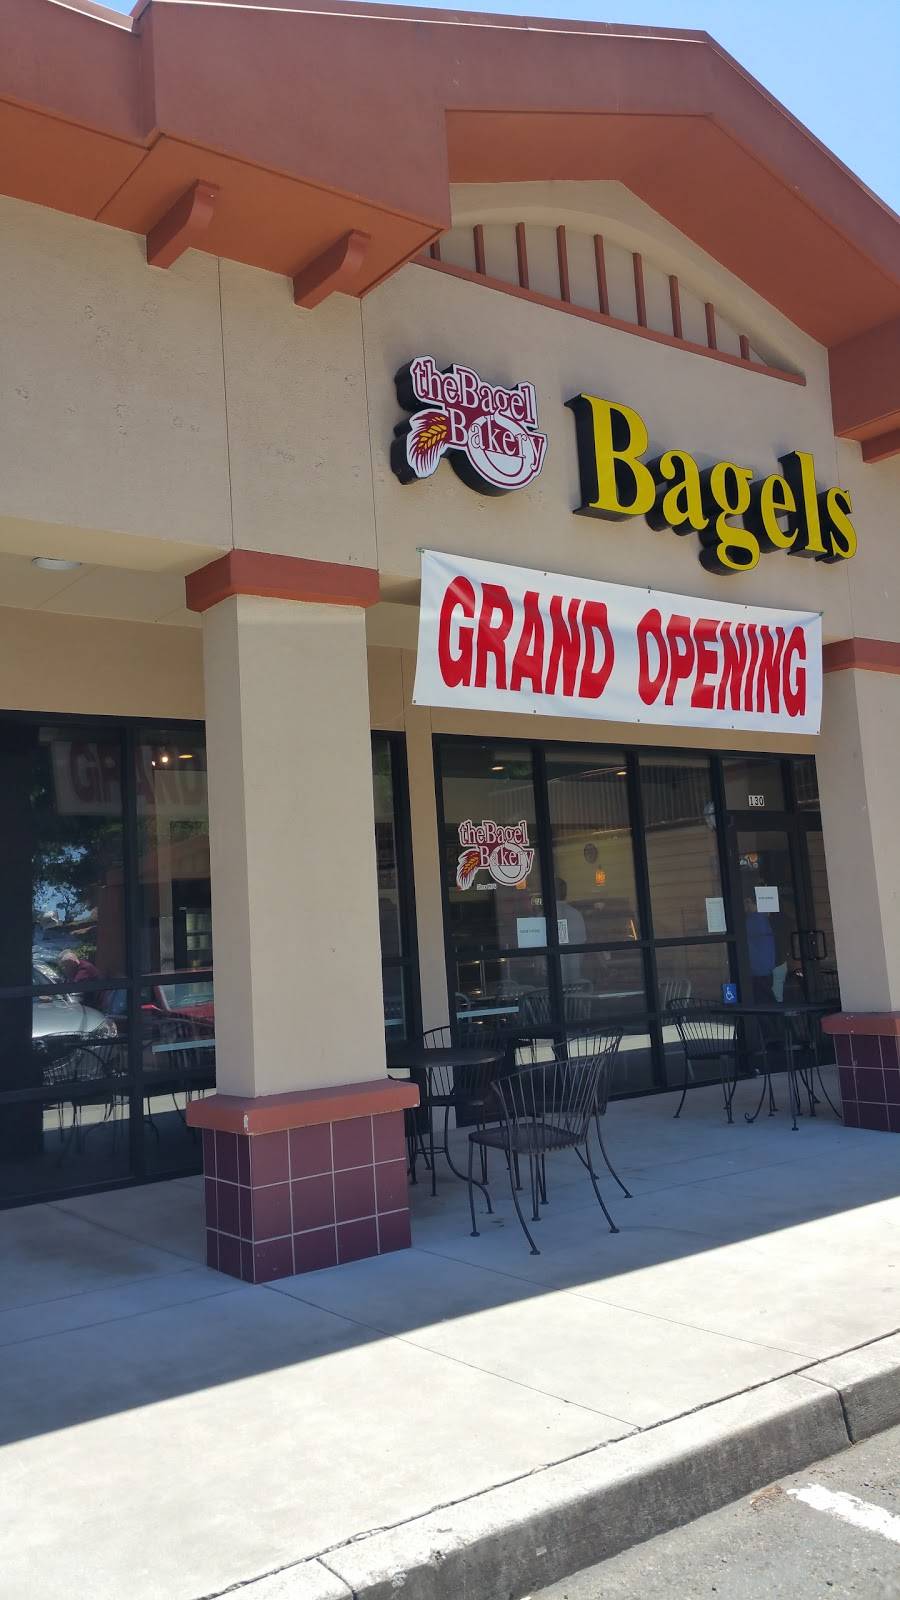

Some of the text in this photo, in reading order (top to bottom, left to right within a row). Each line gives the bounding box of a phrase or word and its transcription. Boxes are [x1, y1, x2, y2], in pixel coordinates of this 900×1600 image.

[447, 407, 545, 470] Bakery
[581, 393, 857, 572] Bagels
[438, 575, 807, 718] GRAND OPENING
[749, 796, 764, 806] 130
